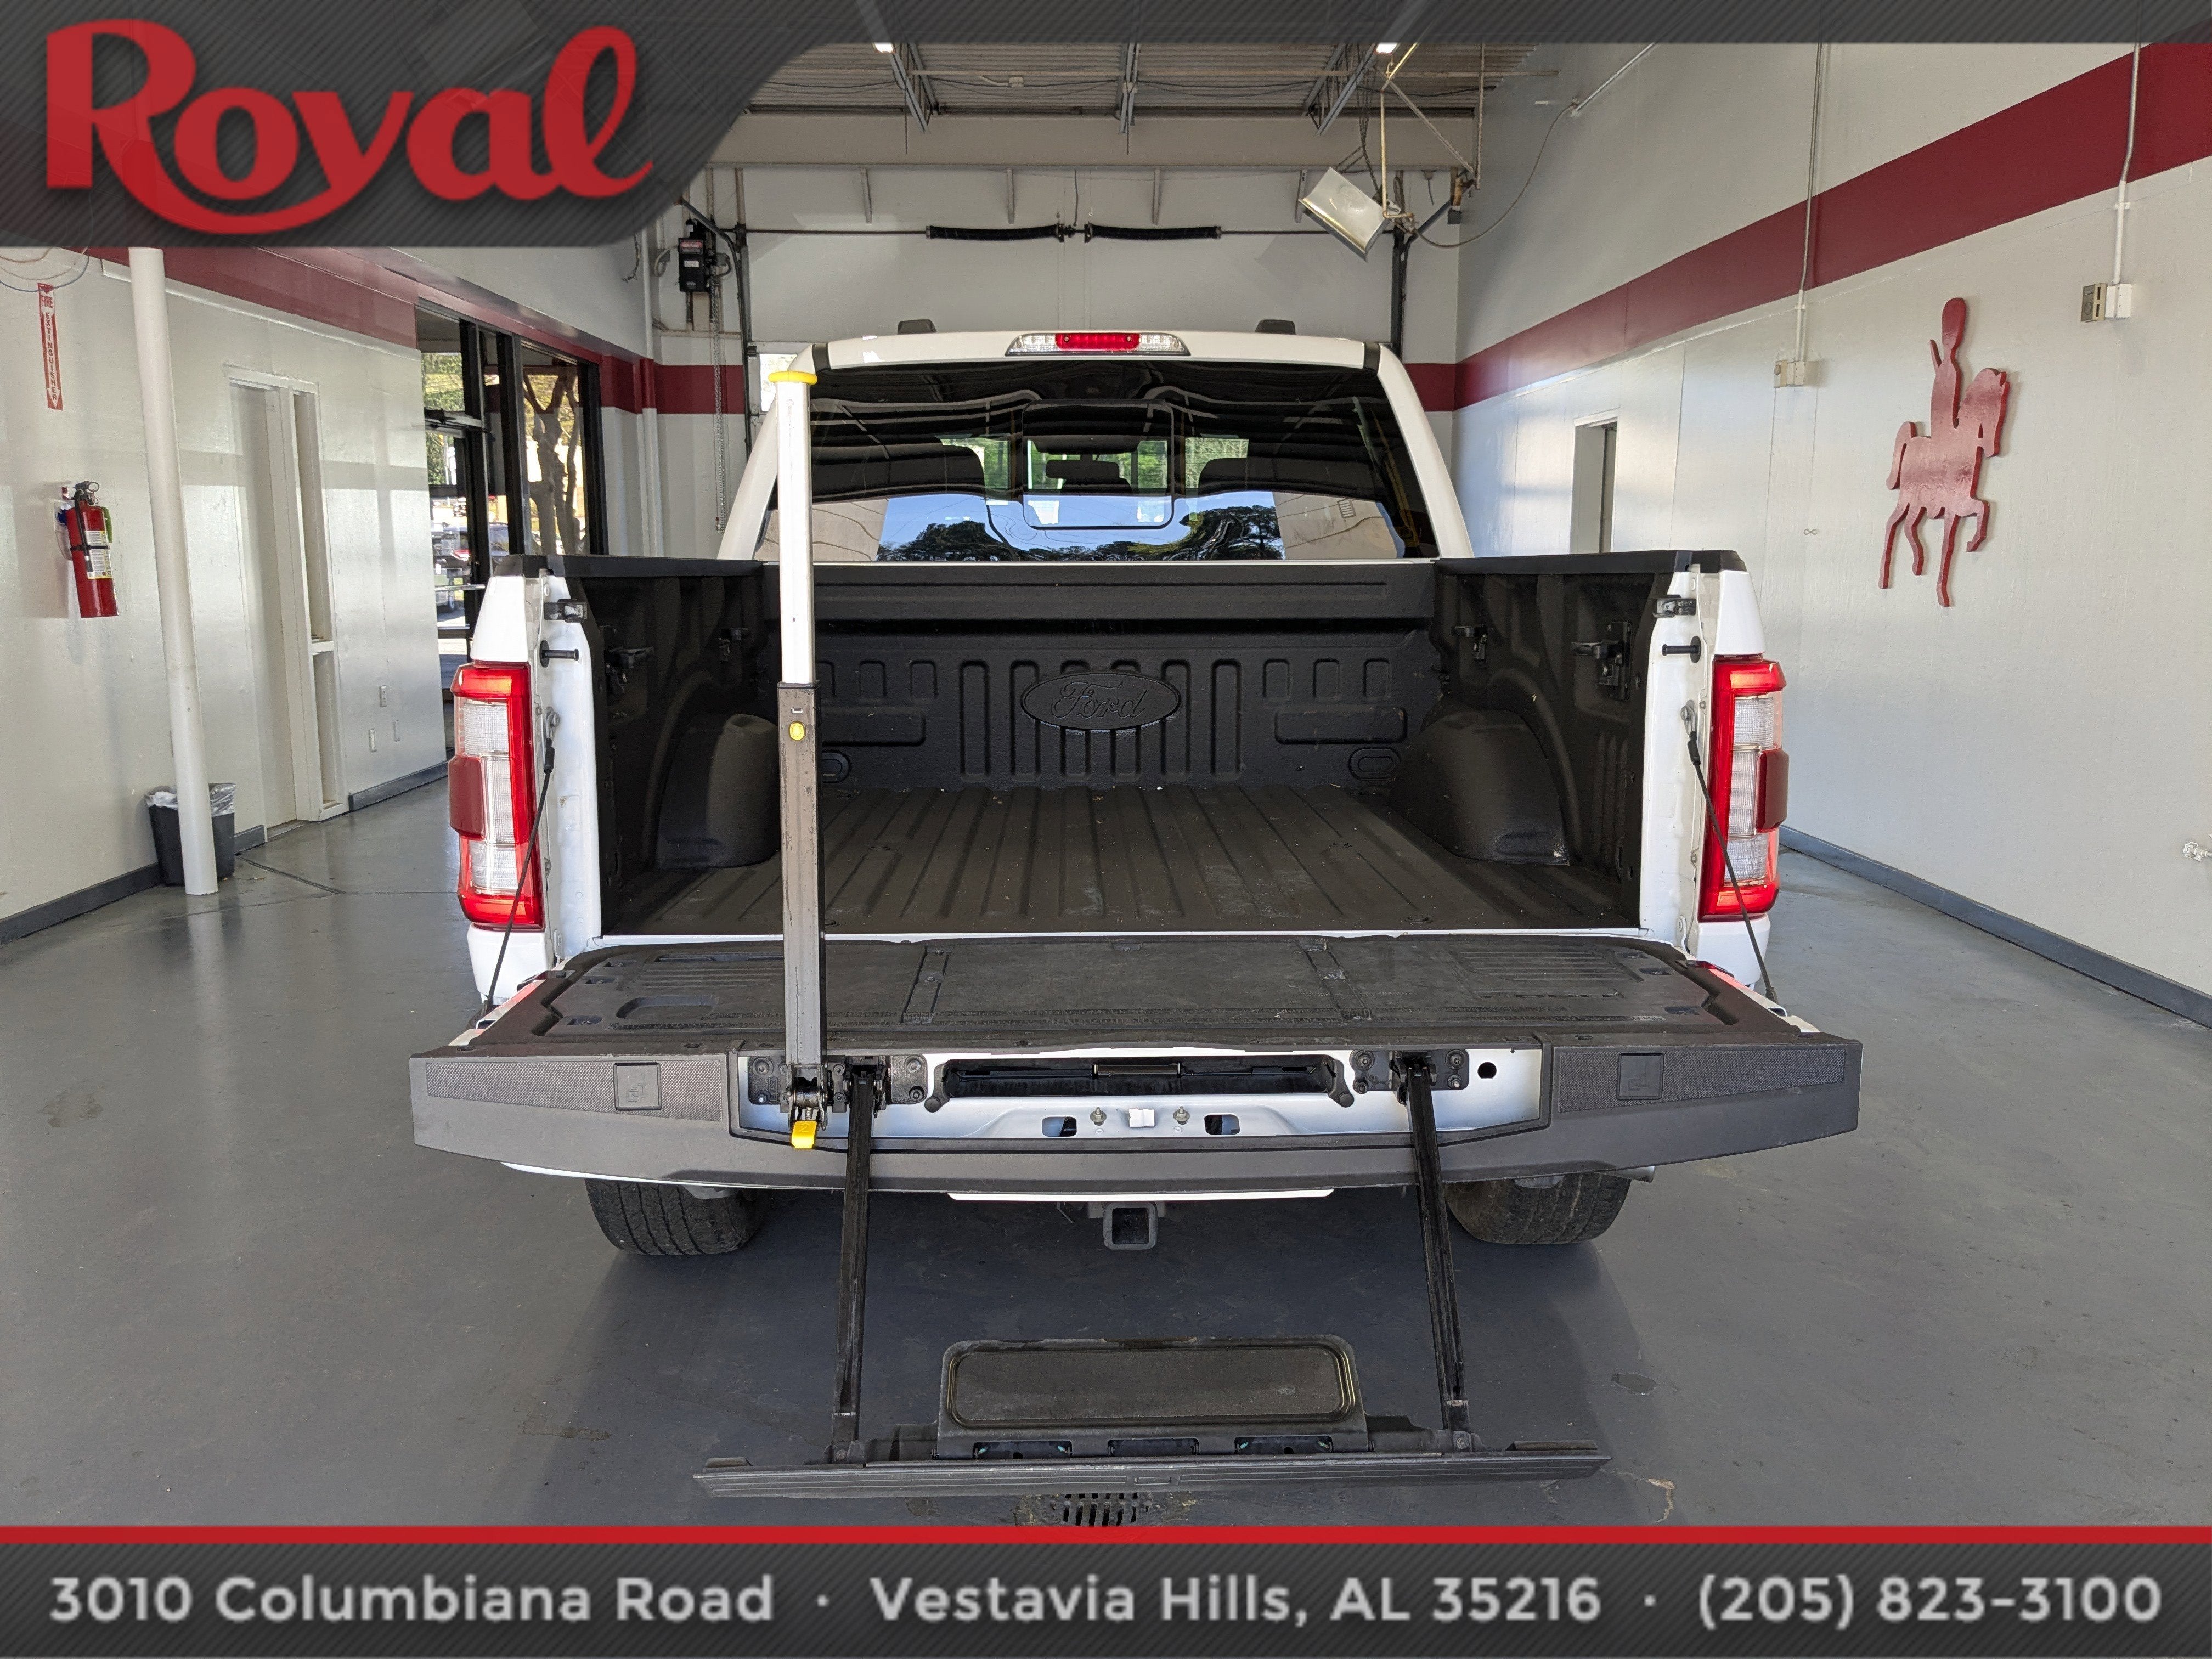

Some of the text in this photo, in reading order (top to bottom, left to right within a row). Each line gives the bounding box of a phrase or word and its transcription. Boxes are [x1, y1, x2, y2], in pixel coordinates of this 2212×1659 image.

[40, 295, 54, 309] FIRE
[45, 312, 58, 402] EXTINGUISHER
[1050, 680, 1149, 720] Ford
